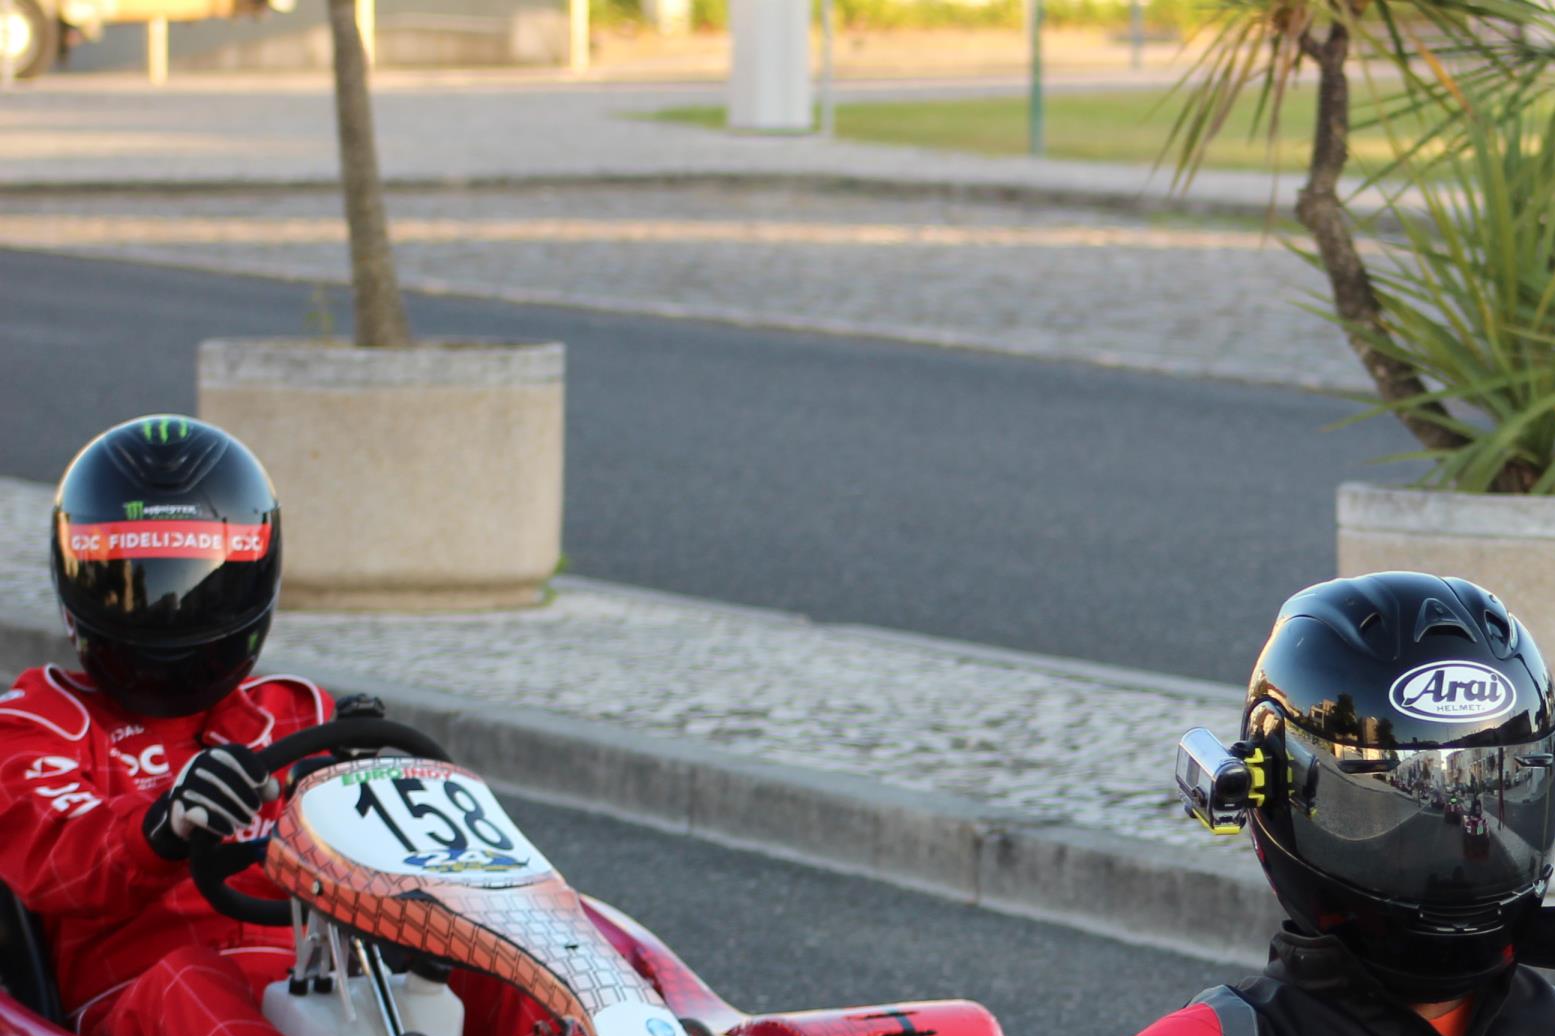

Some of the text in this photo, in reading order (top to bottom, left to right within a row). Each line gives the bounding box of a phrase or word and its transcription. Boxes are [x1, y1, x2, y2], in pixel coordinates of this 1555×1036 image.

[108, 531, 223, 549] FIDELIDADE
[1402, 669, 1502, 707] Arai
[355, 777, 514, 853] 158
